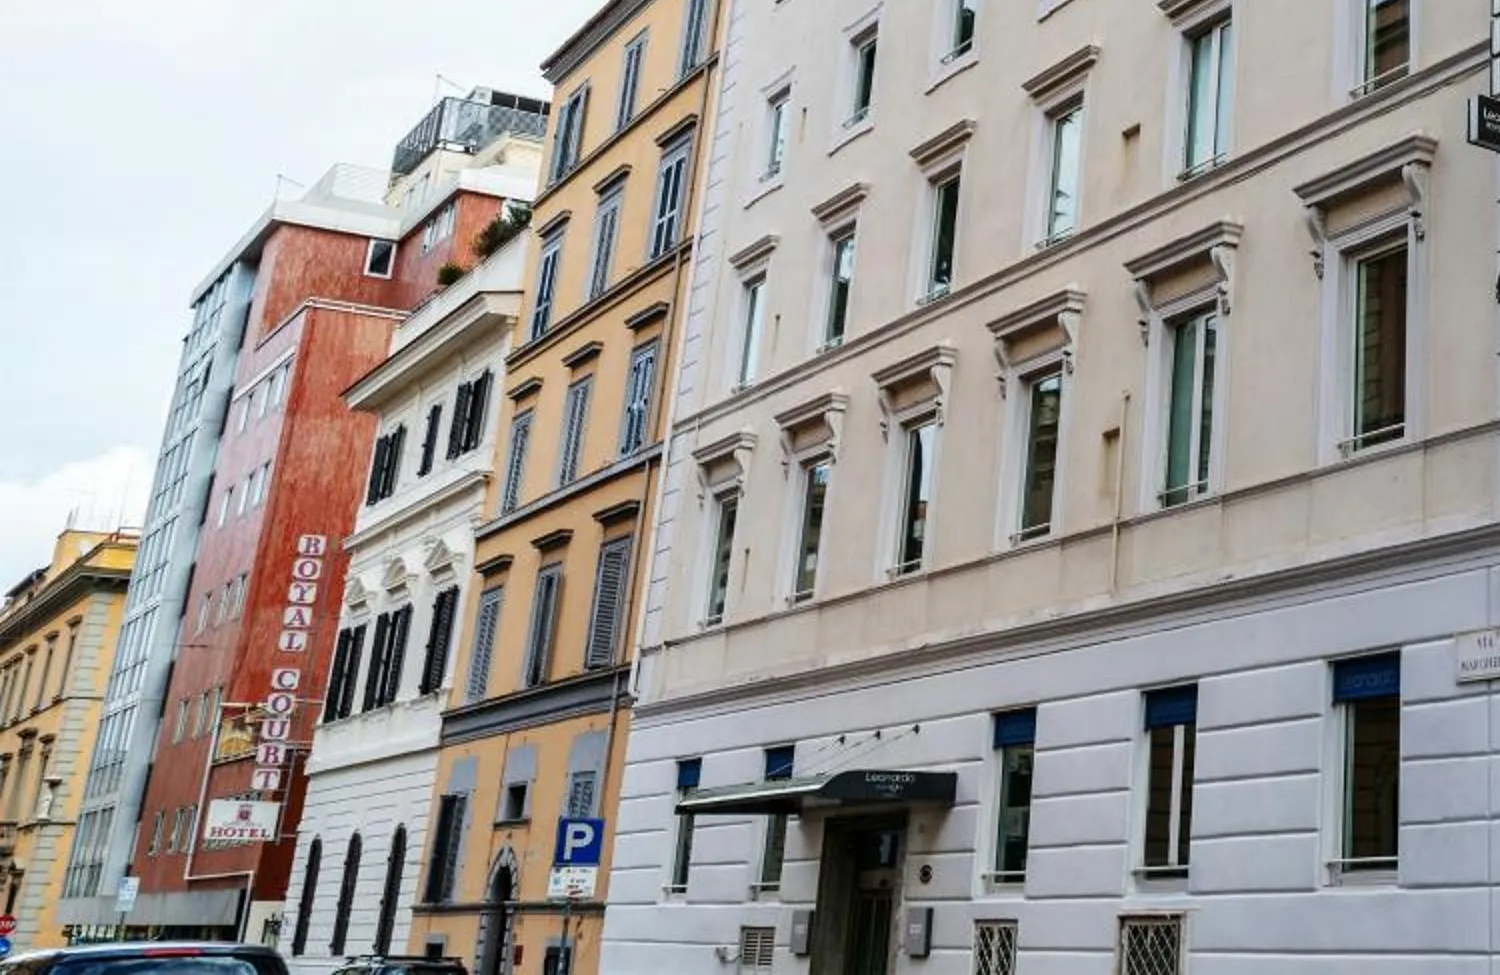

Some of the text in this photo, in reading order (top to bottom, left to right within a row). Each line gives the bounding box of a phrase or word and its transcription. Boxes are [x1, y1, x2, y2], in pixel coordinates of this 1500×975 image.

[255, 536, 321, 789] ROYAL COURT
[864, 772, 916, 783] Leonardo
[210, 825, 271, 839] HOTEL
[563, 822, 595, 860] P
